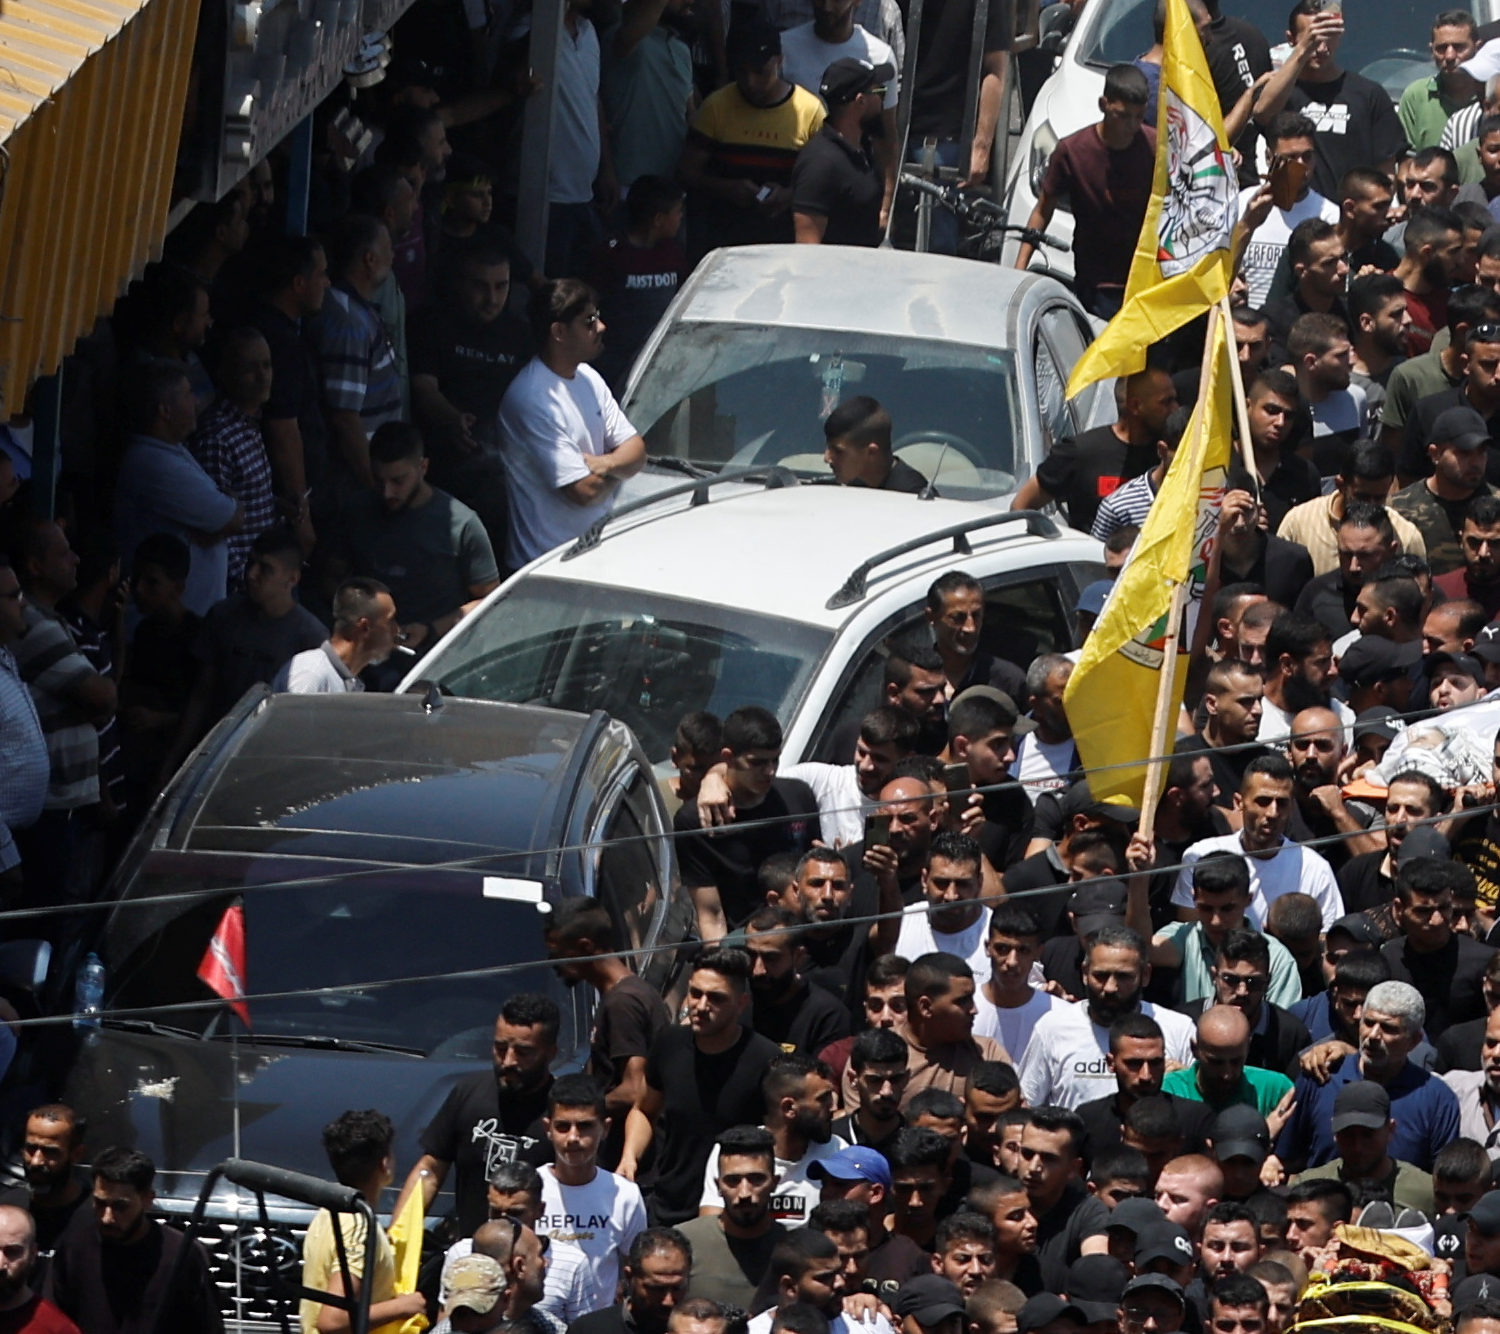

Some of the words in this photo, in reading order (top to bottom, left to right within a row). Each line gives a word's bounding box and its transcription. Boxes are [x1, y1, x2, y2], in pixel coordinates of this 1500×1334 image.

[1231, 42, 1255, 89] REP
[455, 345, 516, 365] REPLAY
[1074, 1059, 1107, 1075] adi
[539, 1214, 611, 1230] REPLAY
